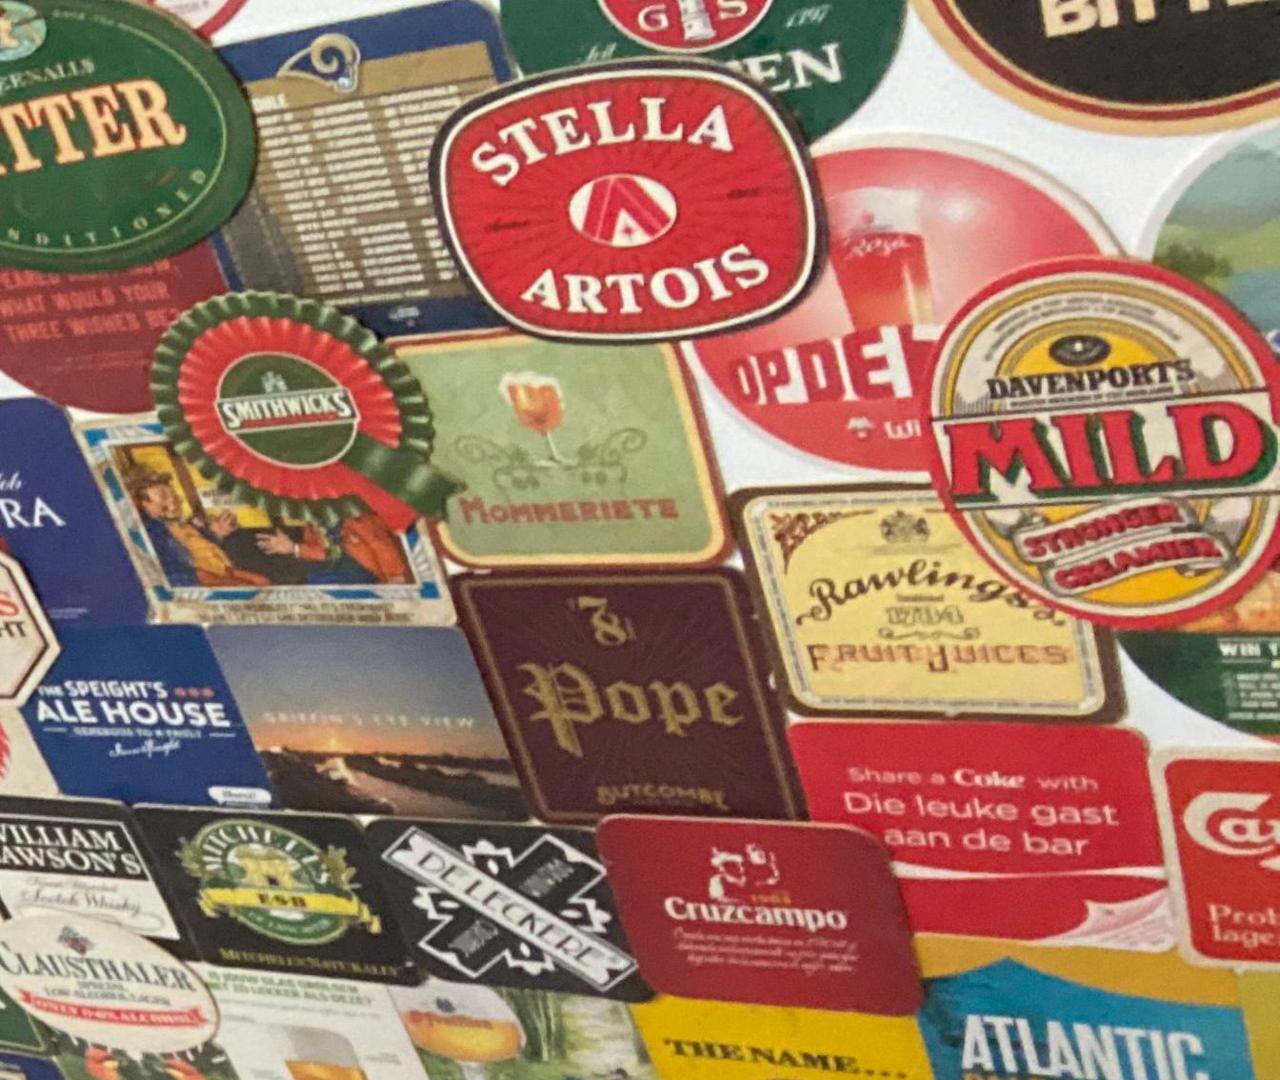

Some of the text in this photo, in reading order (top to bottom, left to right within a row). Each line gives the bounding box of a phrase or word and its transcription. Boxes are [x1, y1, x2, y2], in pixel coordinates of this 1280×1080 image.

[470, 95, 735, 188] STELLA
[520, 243, 771, 317] ARTOIS
[987, 358, 1197, 400] DAVENPORTS
[944, 399, 1272, 502] MILD
[459, 495, 680, 528] MOMMERIETE
[1023, 502, 1184, 558] STRONGER
[1052, 536, 1224, 590] CREAMIER
[807, 641, 1072, 675] FRUIT JUICES
[37, 680, 170, 700] THE SPEIGHT'S
[37, 699, 231, 728] ALE HOUSE
[516, 662, 745, 758] Pope
[596, 784, 731, 811] BUTCOMBE
[848, 766, 1098, 793] Share a Coke with
[844, 791, 1121, 828] Die leuke gast
[884, 827, 1091, 858] aan de bar
[467, 875, 607, 972] LECKERE
[663, 896, 848, 932] Cruzcampo
[665, 1037, 744, 1063] THE
